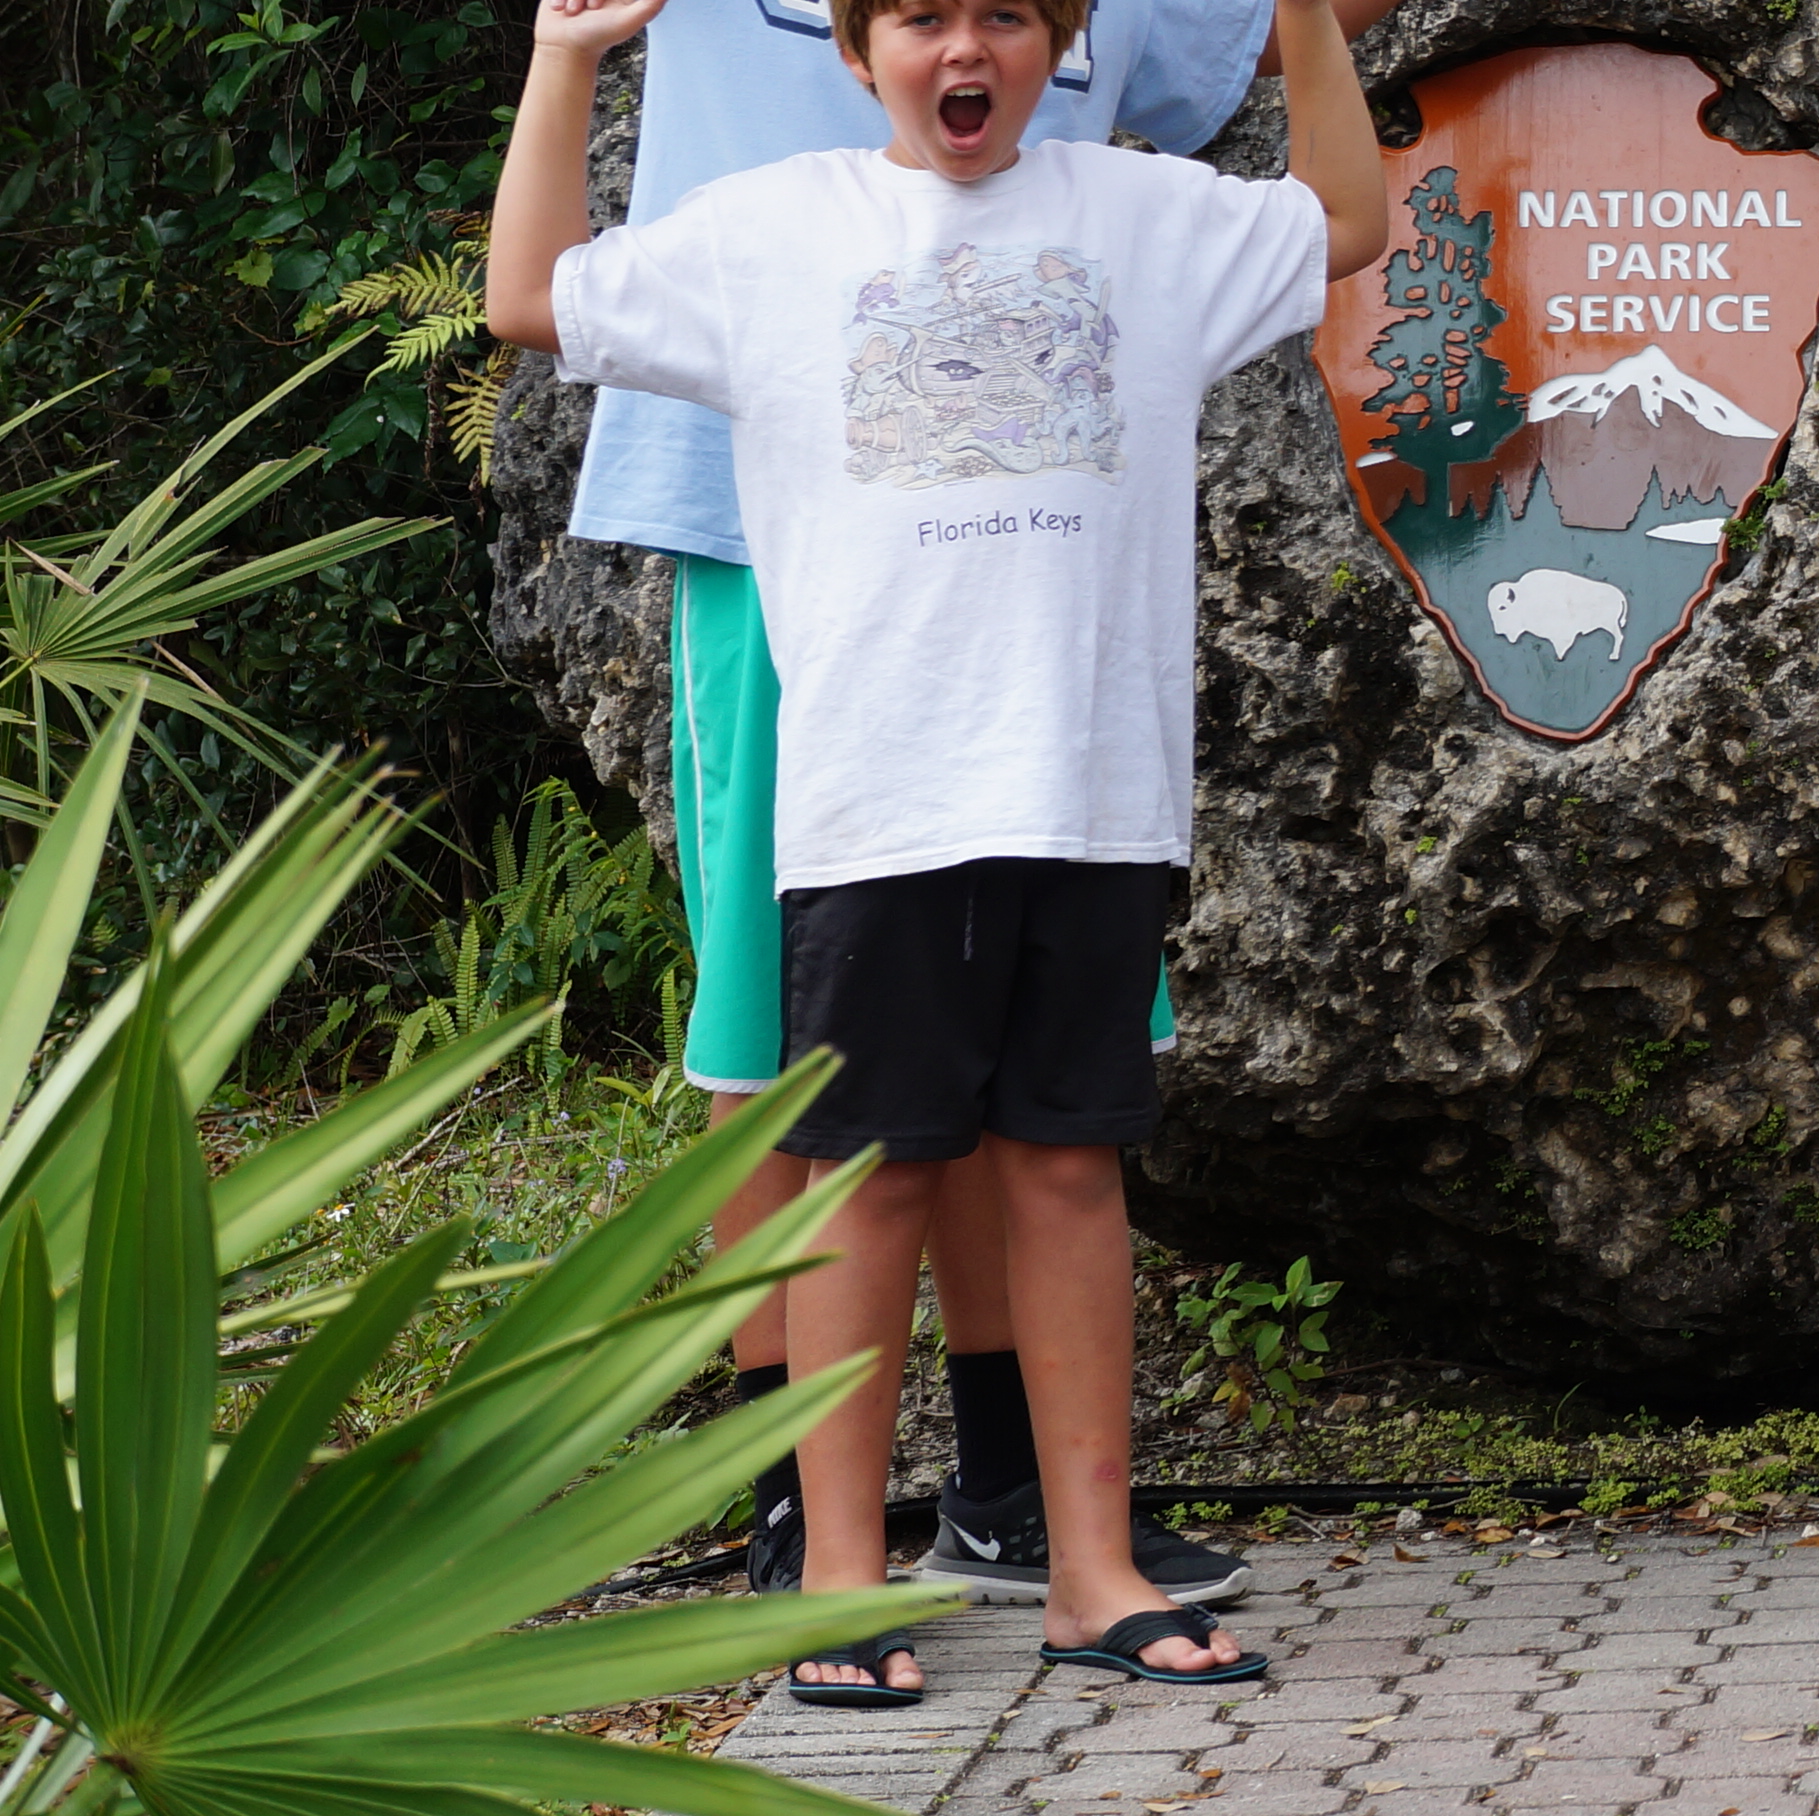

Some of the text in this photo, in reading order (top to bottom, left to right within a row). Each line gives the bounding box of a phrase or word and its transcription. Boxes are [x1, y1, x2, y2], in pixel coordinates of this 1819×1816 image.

[1519, 190, 1803, 229] NATIONAL
[1586, 242, 1732, 281] PARK
[1546, 294, 1772, 334] SERVICE
[917, 507, 1083, 547] Florida Keys
[767, 1496, 793, 1529] NIKE
